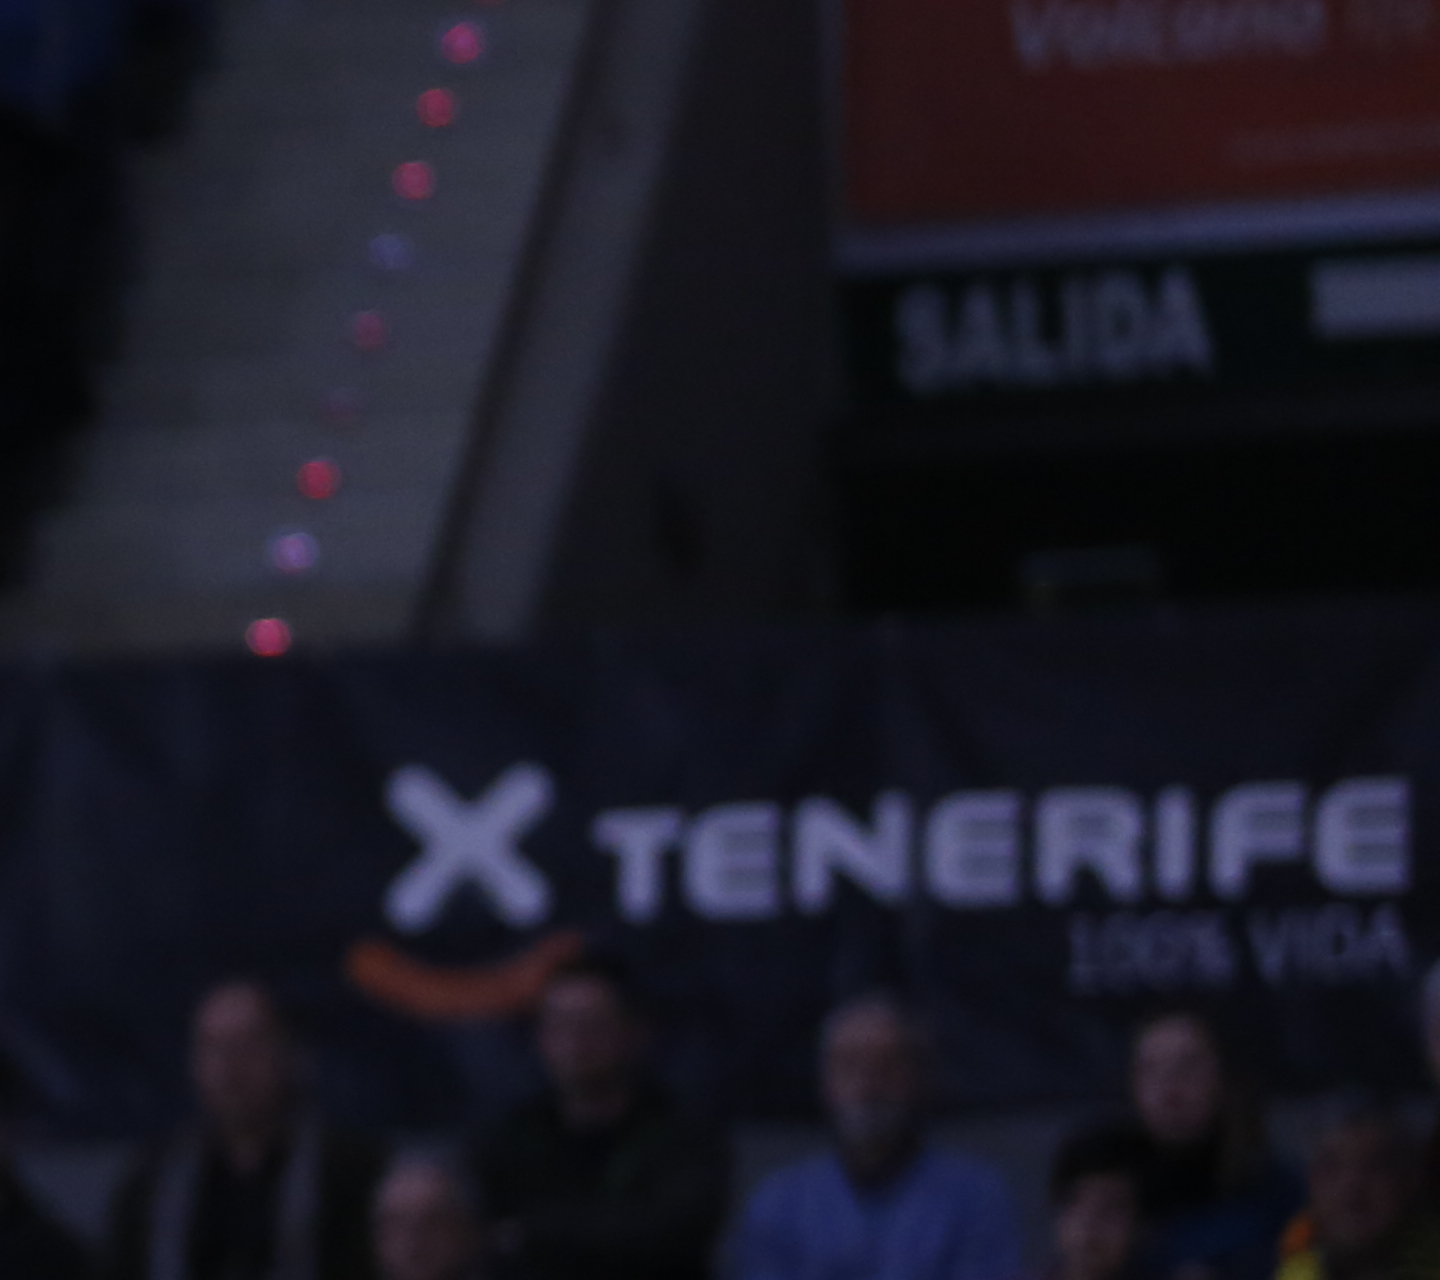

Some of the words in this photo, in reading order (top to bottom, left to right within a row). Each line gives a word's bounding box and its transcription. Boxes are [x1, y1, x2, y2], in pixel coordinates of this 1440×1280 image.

[890, 270, 1217, 398] SALIDA
[591, 774, 1414, 926] TENERIFE
[1068, 910, 1236, 996] 100%
[1245, 902, 1413, 990] VIDA
